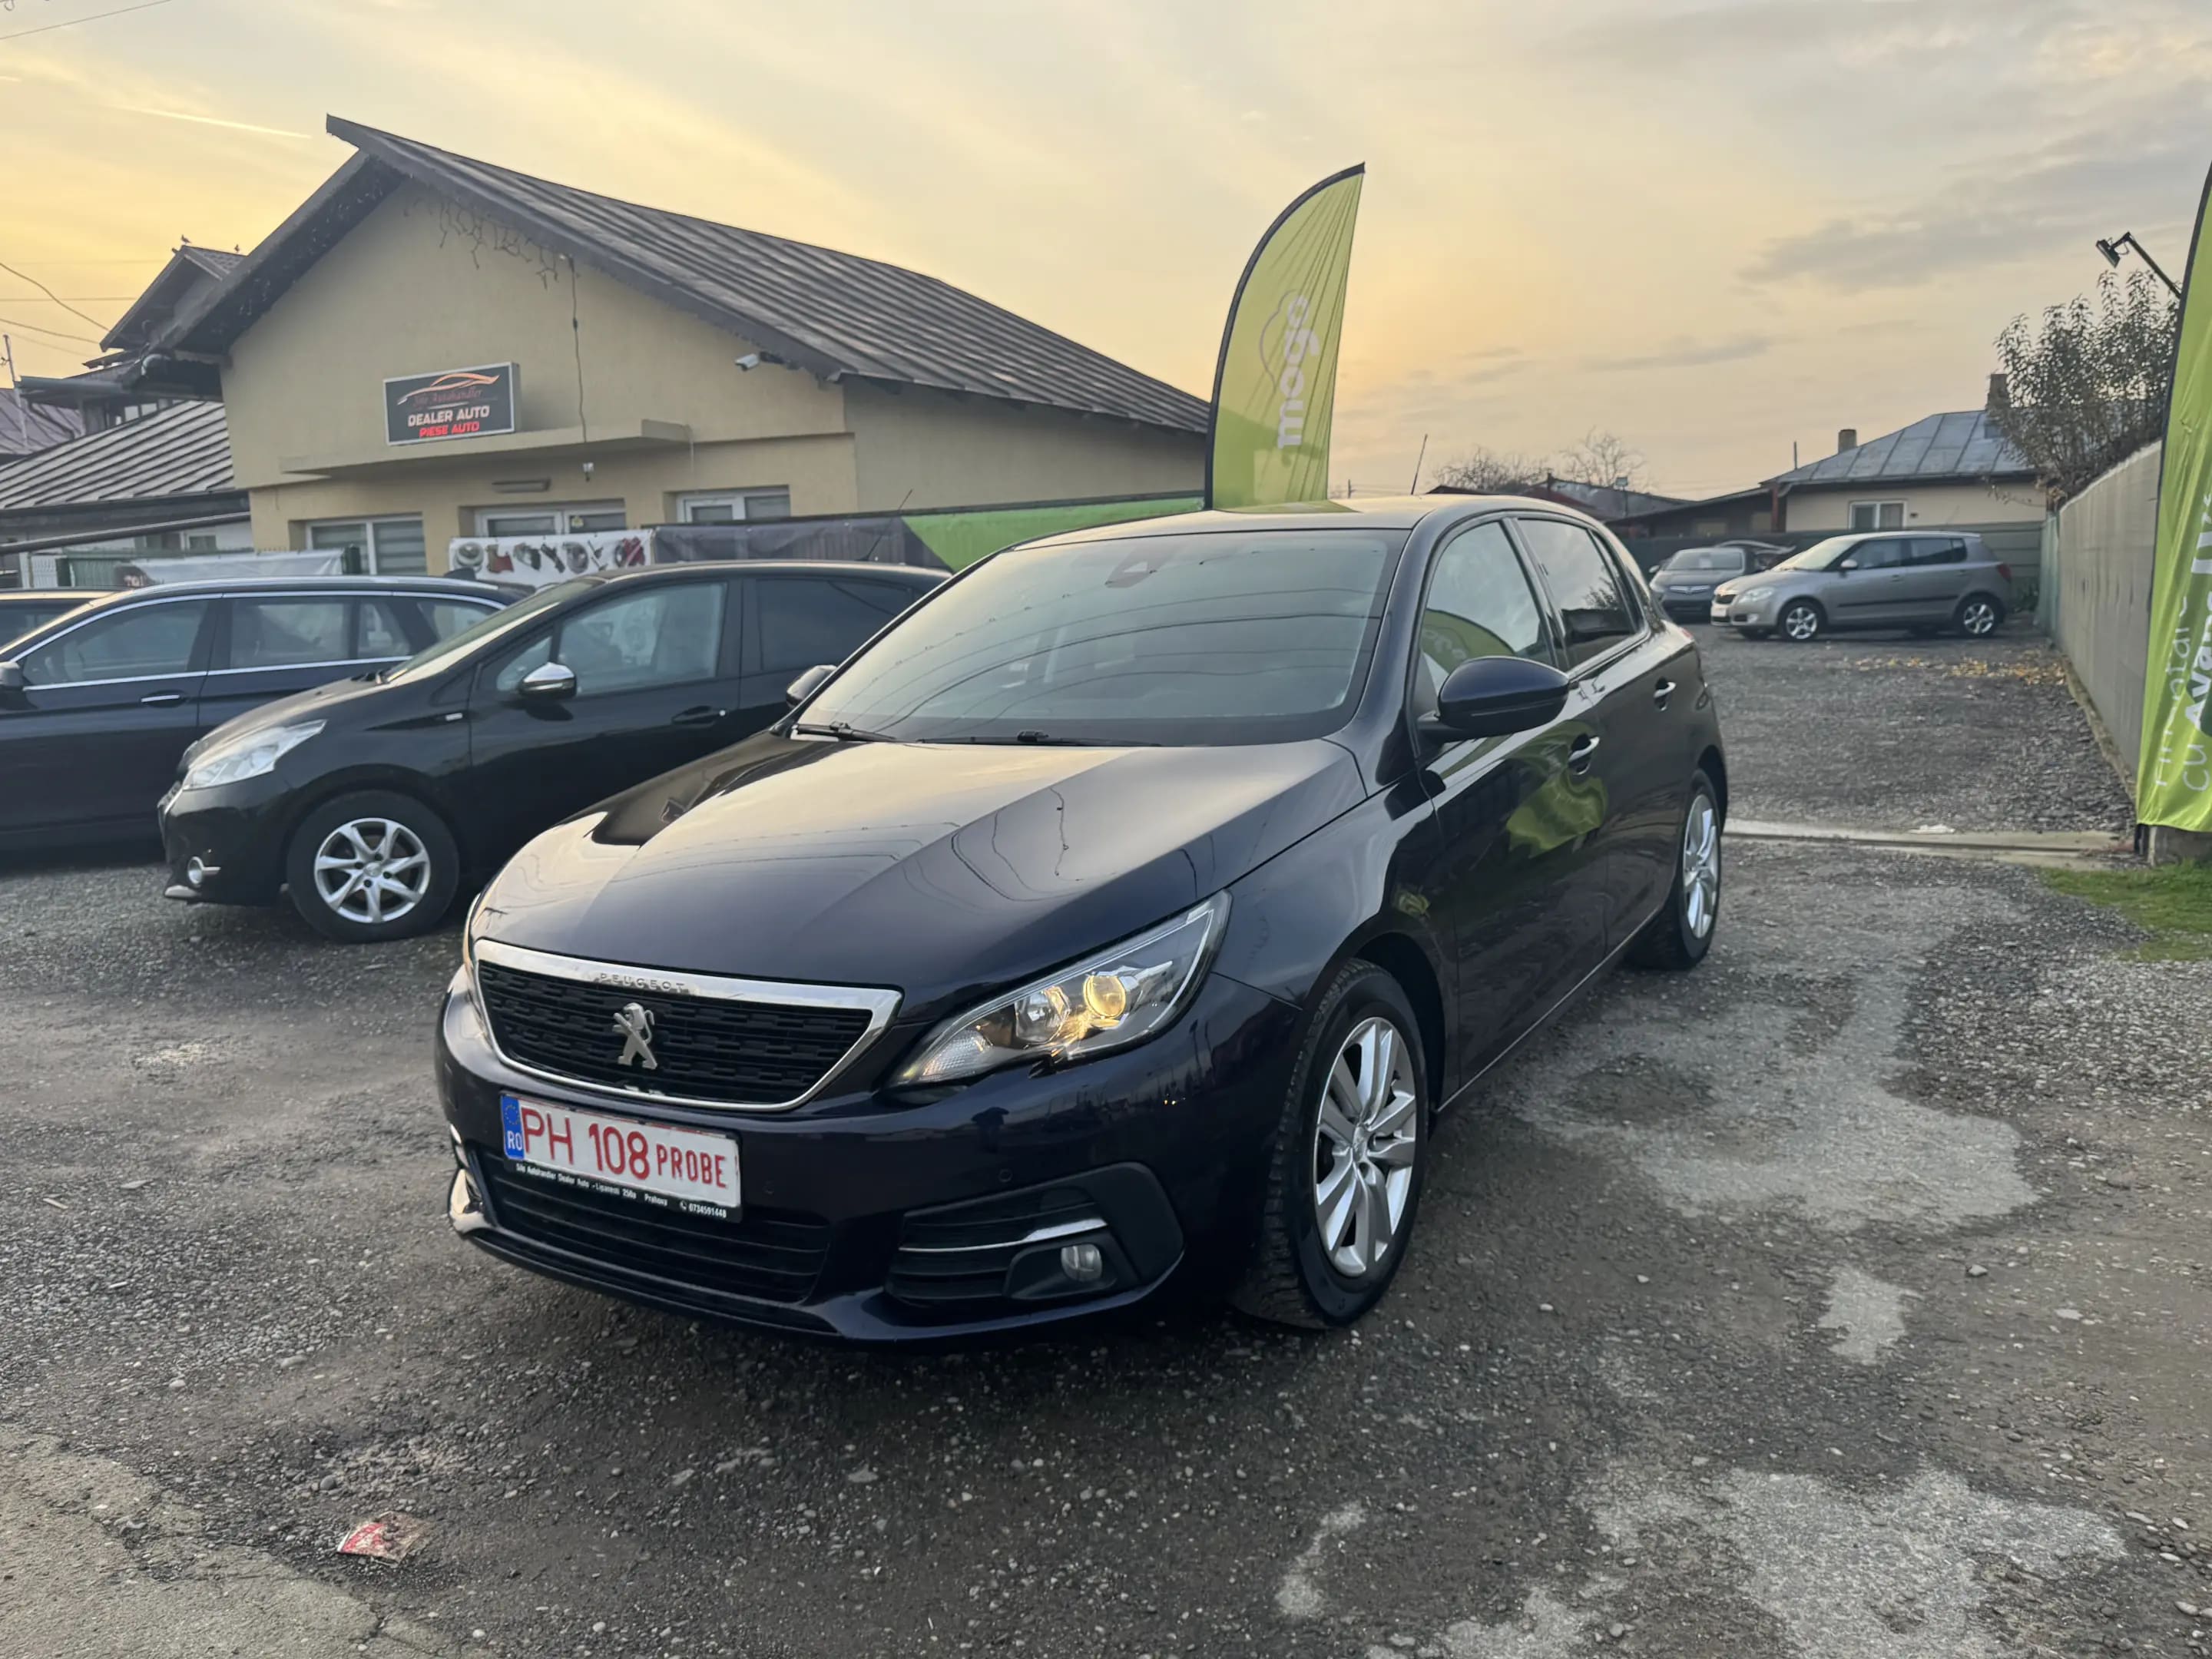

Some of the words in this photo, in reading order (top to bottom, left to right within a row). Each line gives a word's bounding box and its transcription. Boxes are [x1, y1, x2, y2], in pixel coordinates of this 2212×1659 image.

[1277, 294, 1320, 449] mogo
[408, 409, 453, 427] DEALER
[456, 405, 490, 420] AUTO
[419, 425, 449, 438] PIESE
[452, 422, 479, 434] AUTO
[600, 972, 686, 994] PEUGEOT
[507, 1131, 522, 1151] RO
[521, 1107, 574, 1165] PH
[588, 1123, 650, 1180] 108
[656, 1143, 728, 1189] PROBE
